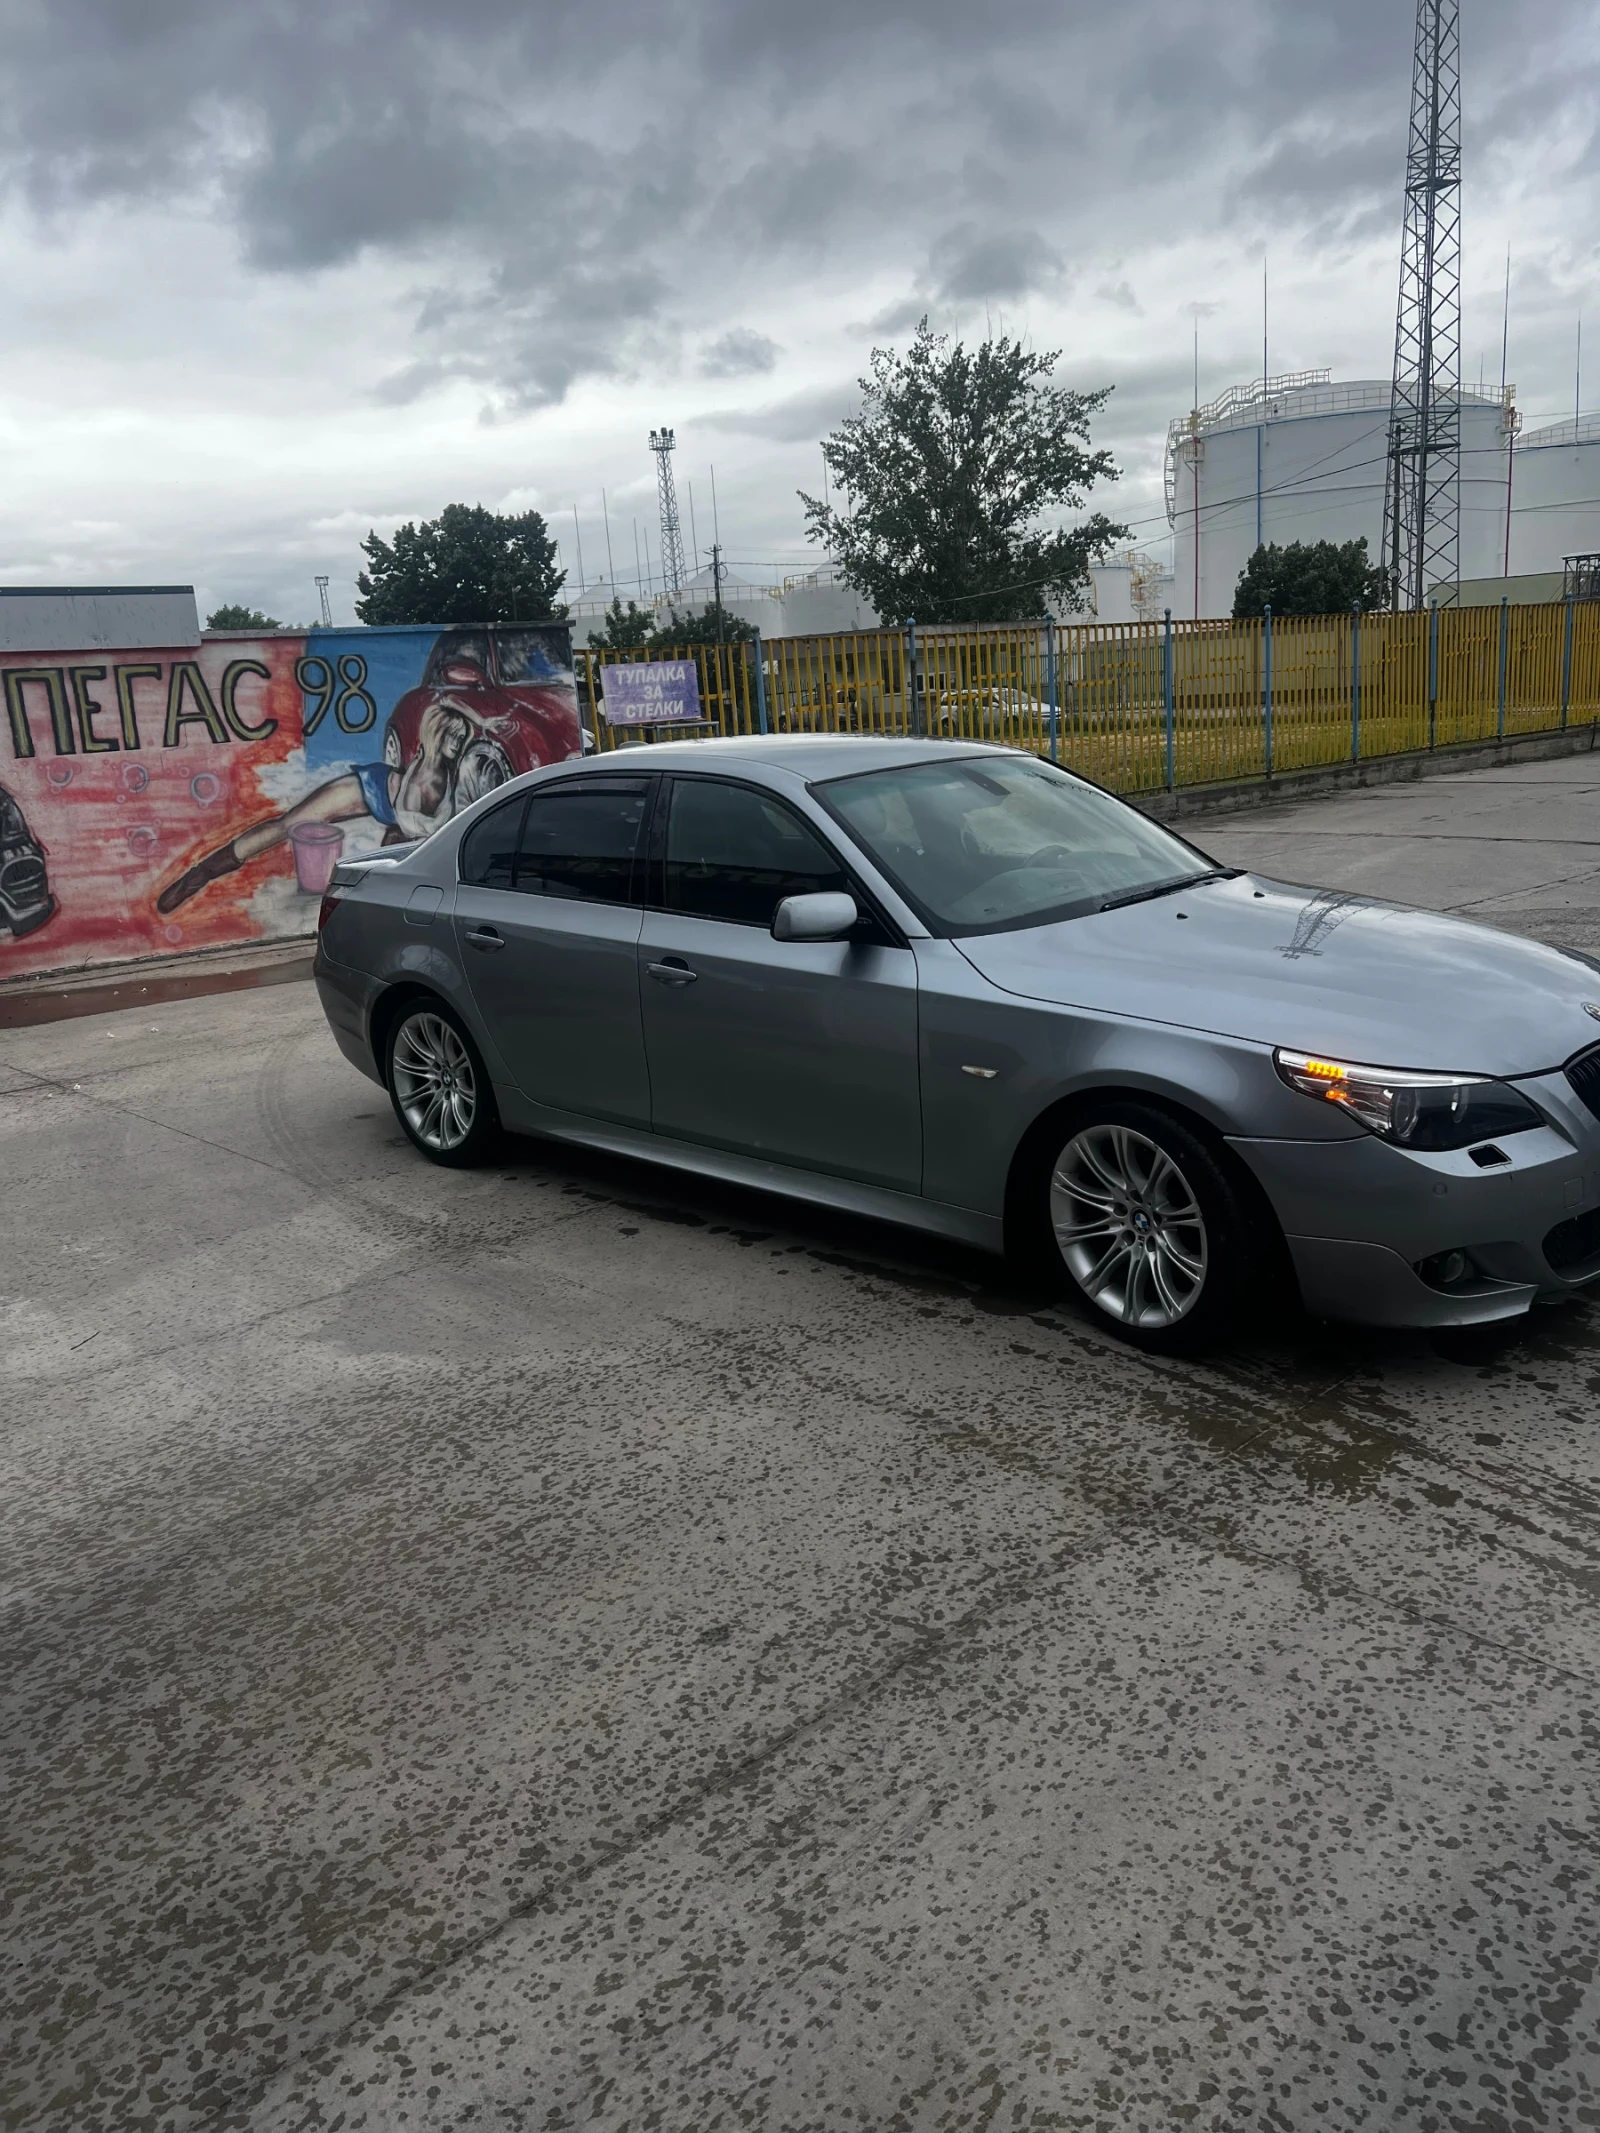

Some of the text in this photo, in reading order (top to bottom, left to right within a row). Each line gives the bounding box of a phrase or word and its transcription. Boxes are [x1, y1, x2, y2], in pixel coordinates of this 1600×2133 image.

[616, 666, 686, 685] ТУПАЛКА
[643, 684, 664, 700] ЗА
[2, 653, 377, 759] ПЕГАС 98
[625, 700, 684, 718] СТЕЛКИ
